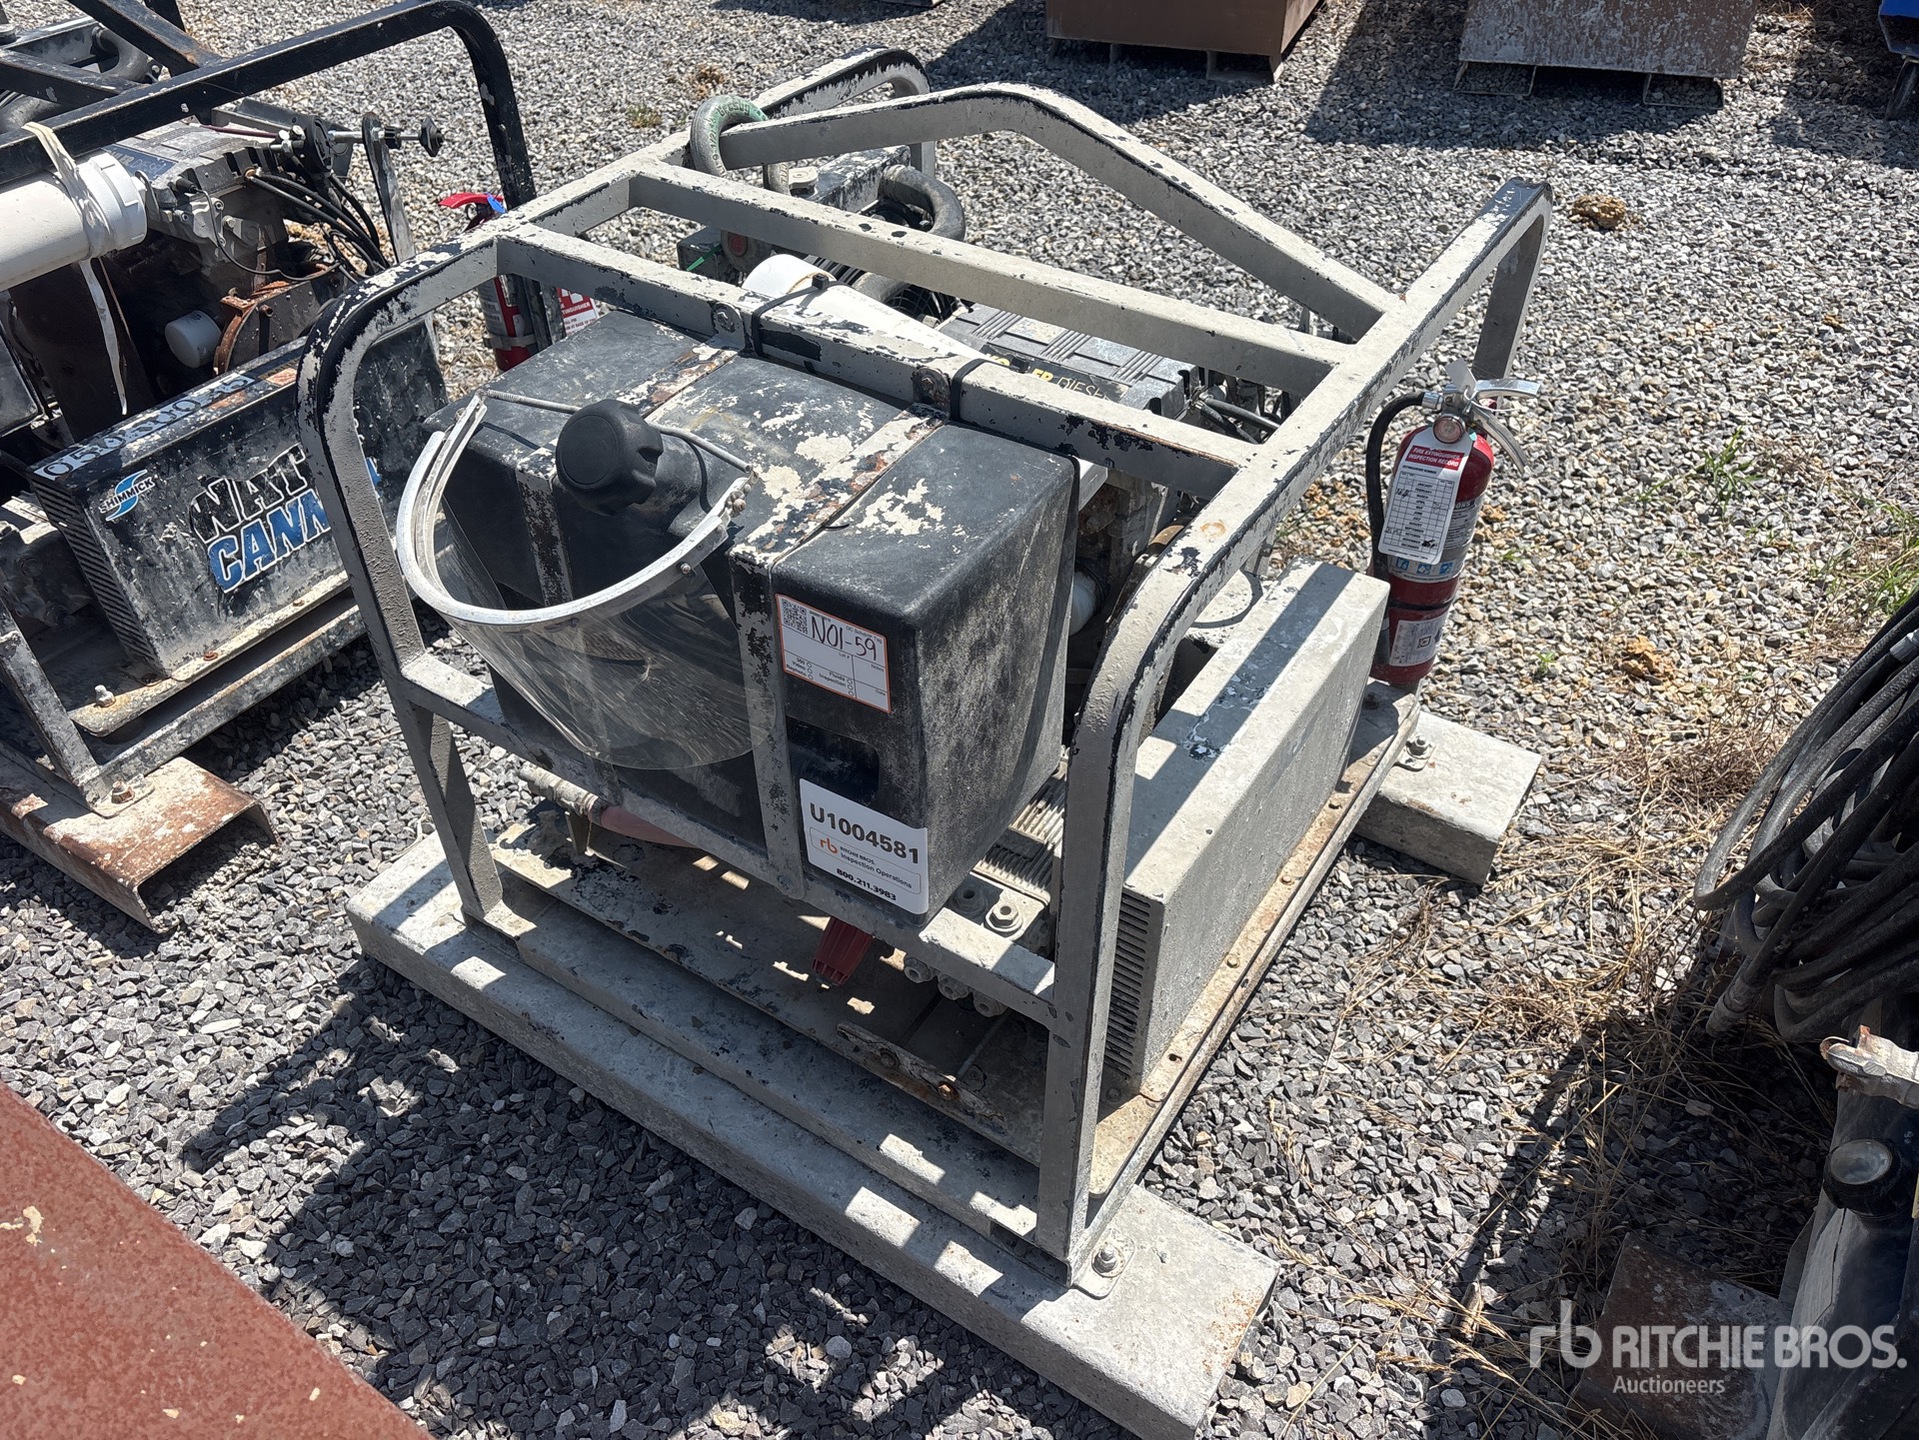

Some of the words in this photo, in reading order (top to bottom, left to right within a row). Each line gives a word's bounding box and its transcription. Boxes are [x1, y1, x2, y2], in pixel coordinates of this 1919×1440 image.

[1408, 454, 1438, 463] INSPECTION
[1438, 459, 1460, 467] RECORD
[99, 476, 155, 514] SHIMMICK
[809, 802, 919, 864] U1004581
[840, 852, 875, 872] Inspection
[875, 867, 912, 889] Operations
